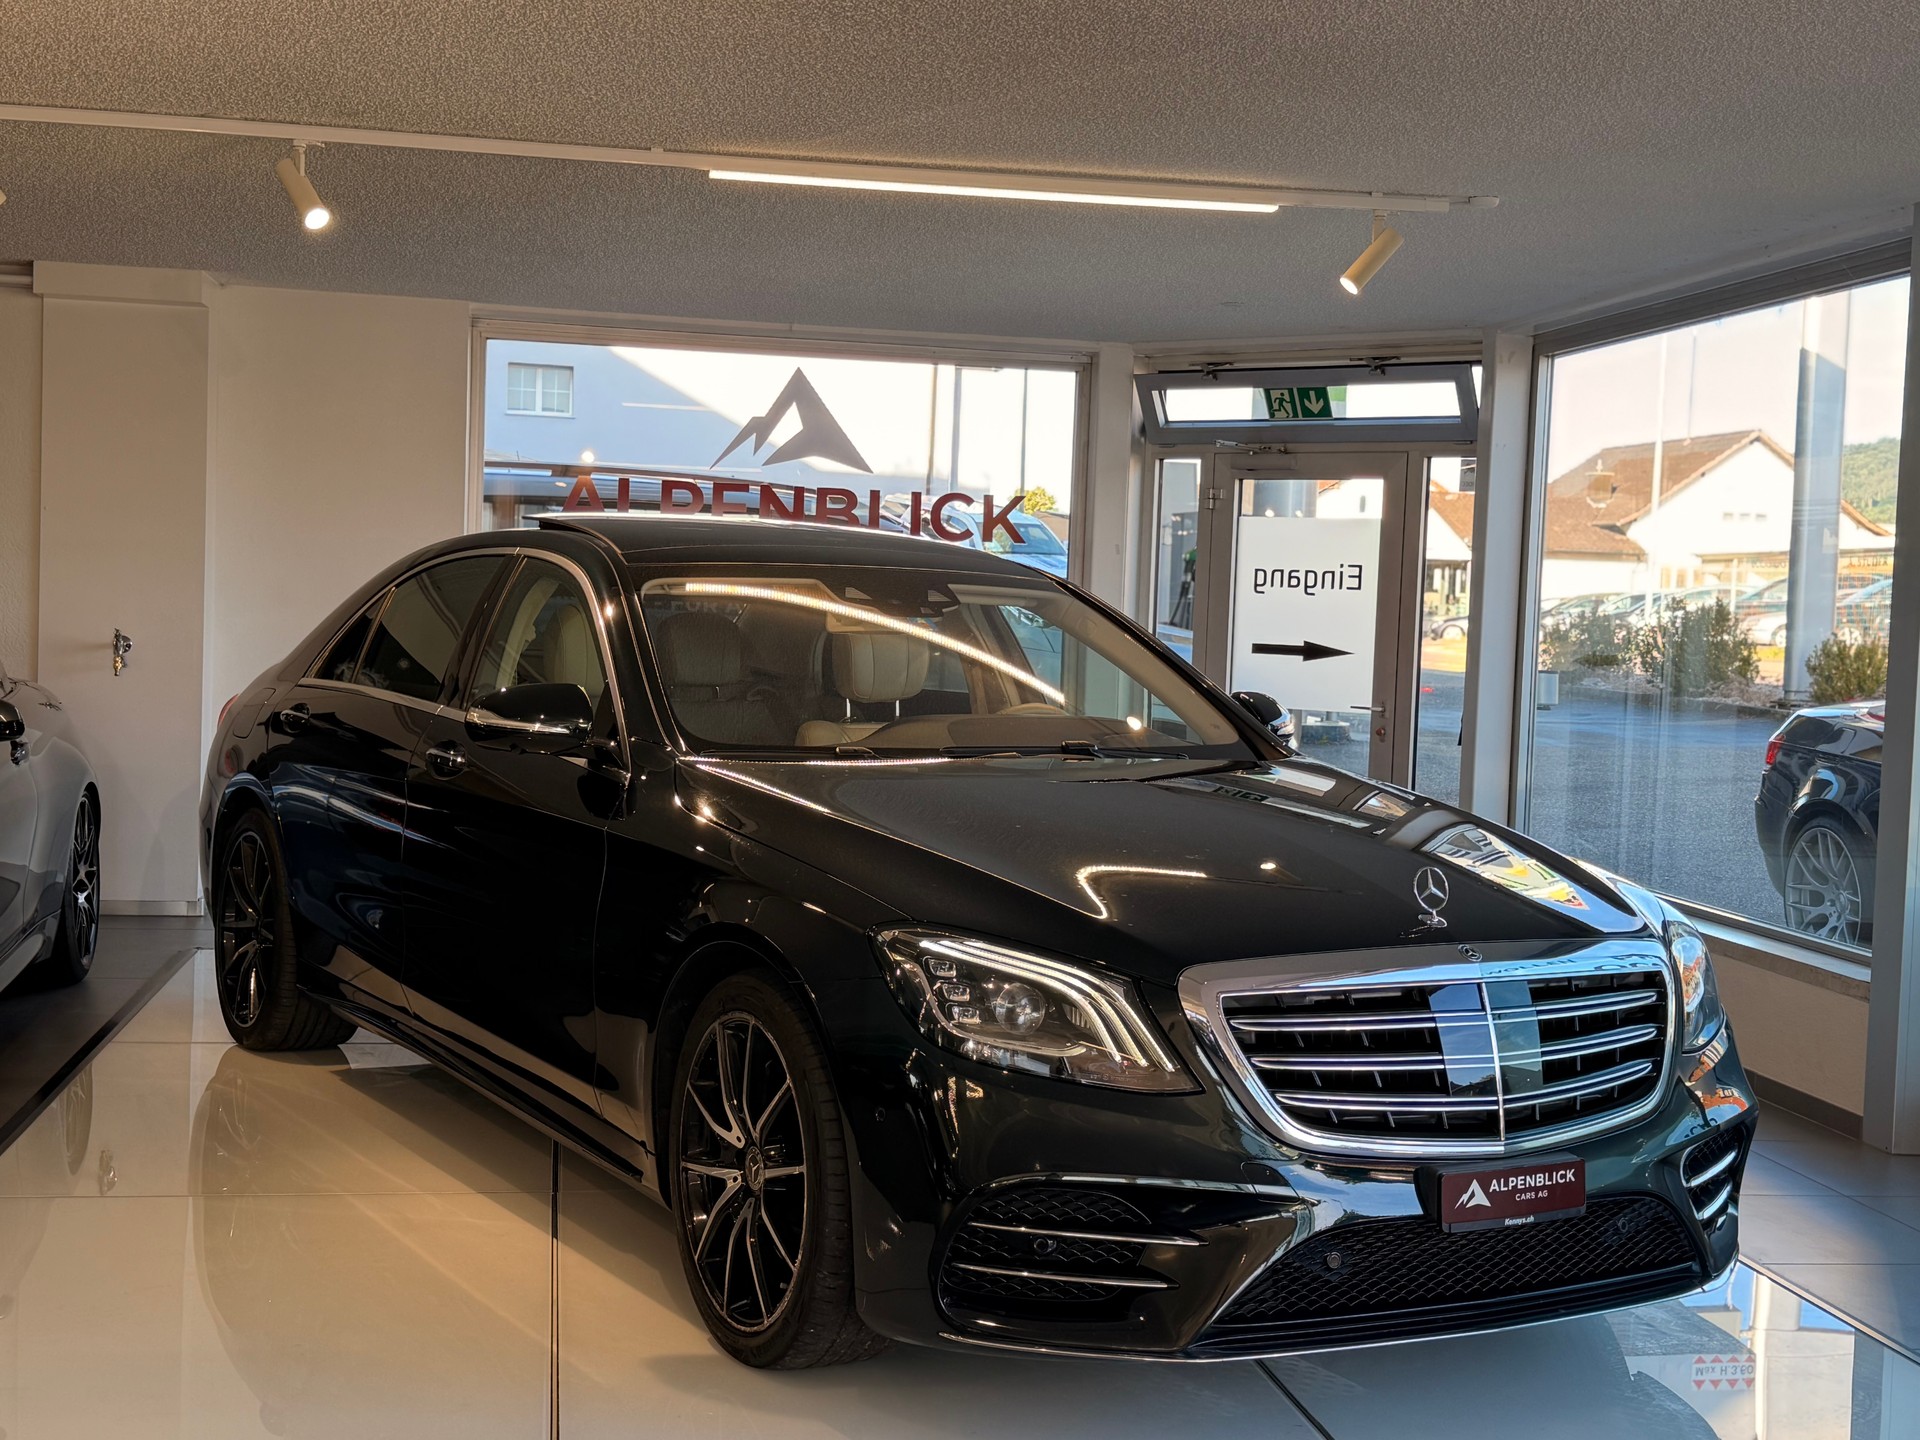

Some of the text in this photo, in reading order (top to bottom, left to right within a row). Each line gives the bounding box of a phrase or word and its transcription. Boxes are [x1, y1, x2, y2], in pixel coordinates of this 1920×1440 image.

[1489, 1168, 1575, 1192] ALPENBLICK
[1515, 1189, 1548, 1201] CARS AG
